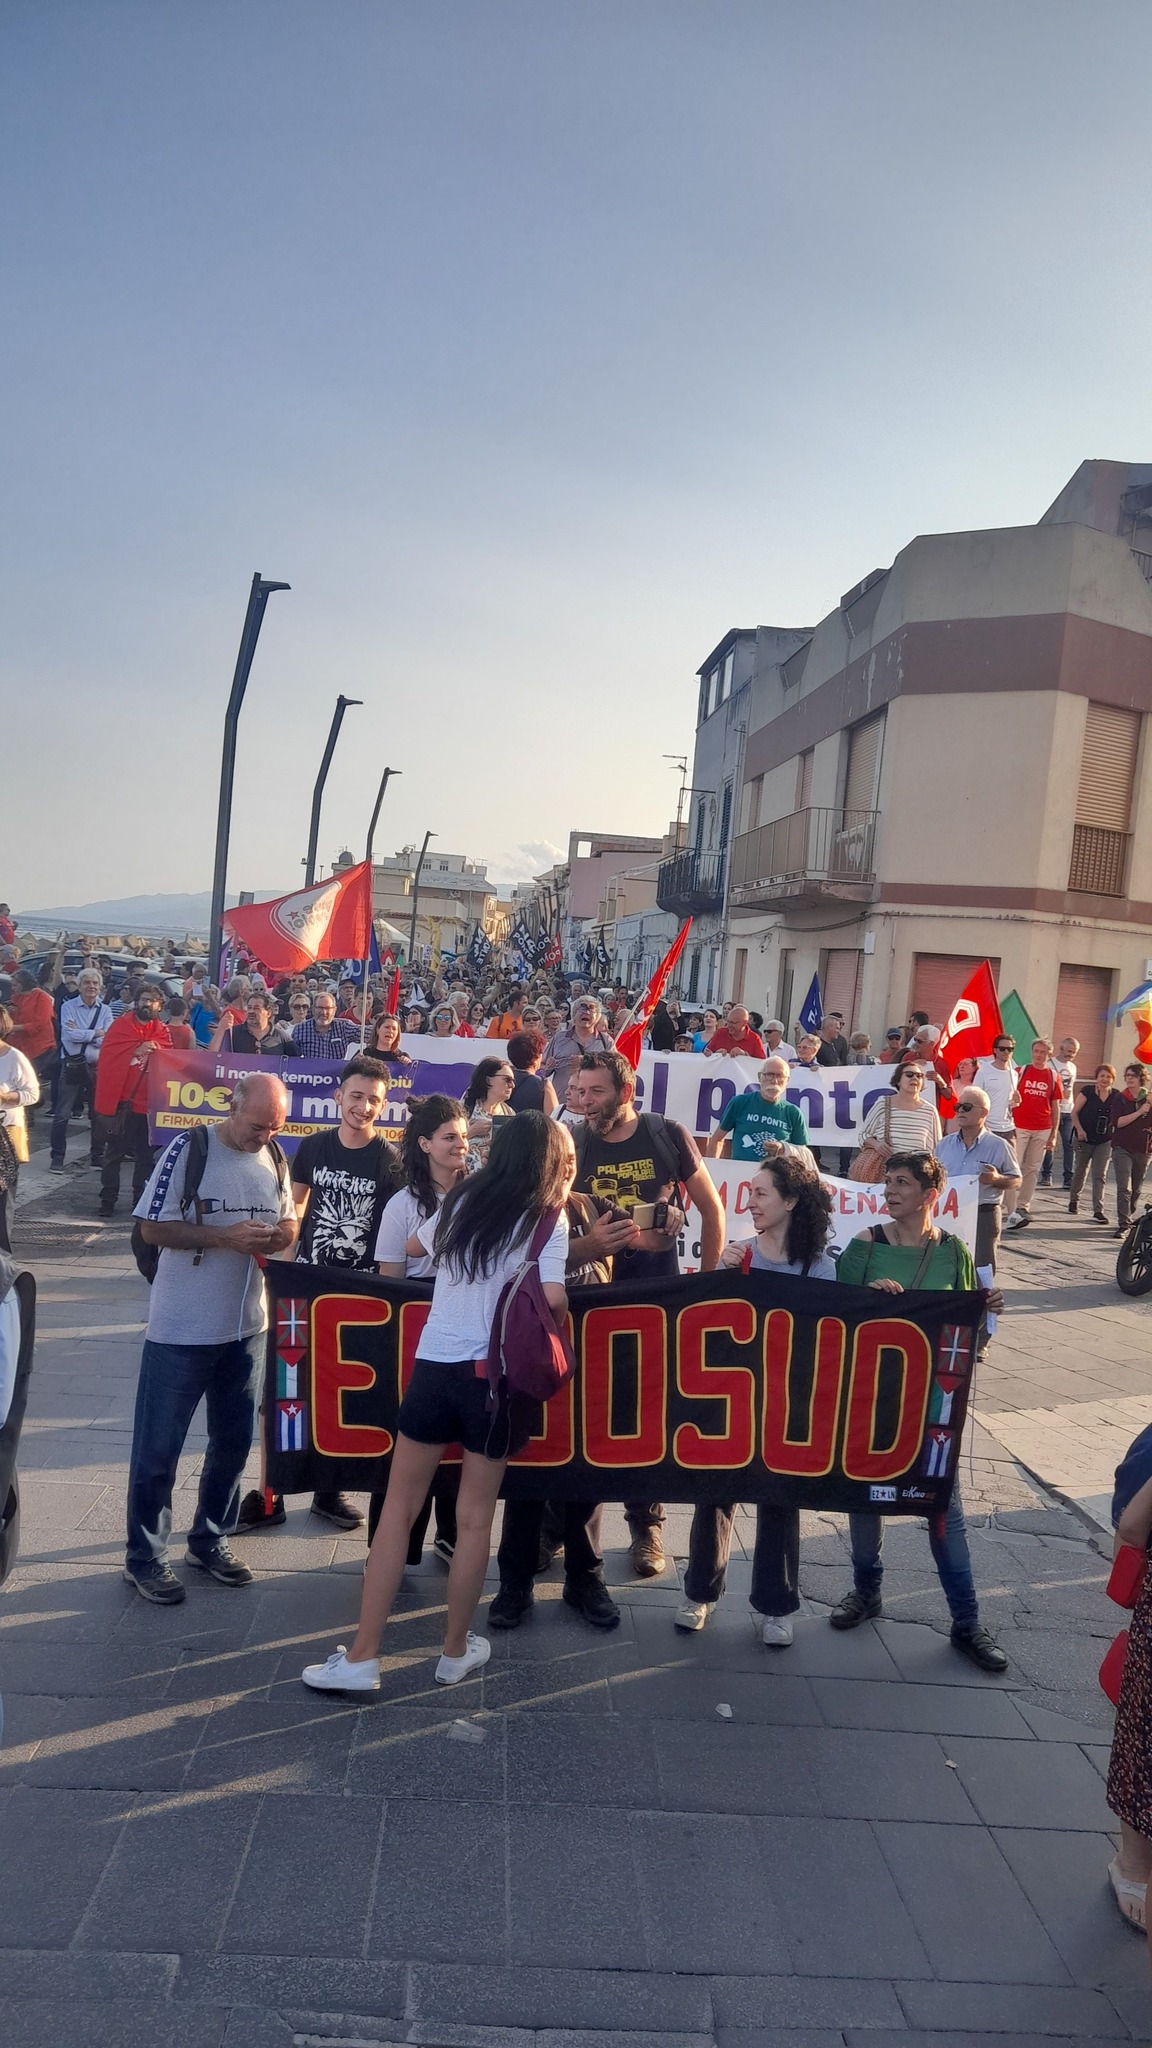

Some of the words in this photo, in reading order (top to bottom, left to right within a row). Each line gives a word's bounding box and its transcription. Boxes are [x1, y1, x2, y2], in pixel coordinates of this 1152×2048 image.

[215, 1065, 225, 1079] il
[282, 1072, 333, 1087] tempo
[388, 1074, 412, 1090] più
[1025, 1080, 1049, 1091] NO
[166, 1081, 233, 1112] 10€
[1023, 1088, 1048, 1098] PONTE
[162, 1115, 203, 1127] FIRMA
[746, 1113, 760, 1122] NO
[761, 1115, 788, 1130] PONTE
[597, 1158, 654, 1176] PALESTRA
[201, 1198, 277, 1220] Champion
[312, 1294, 932, 1482] EOSUD
